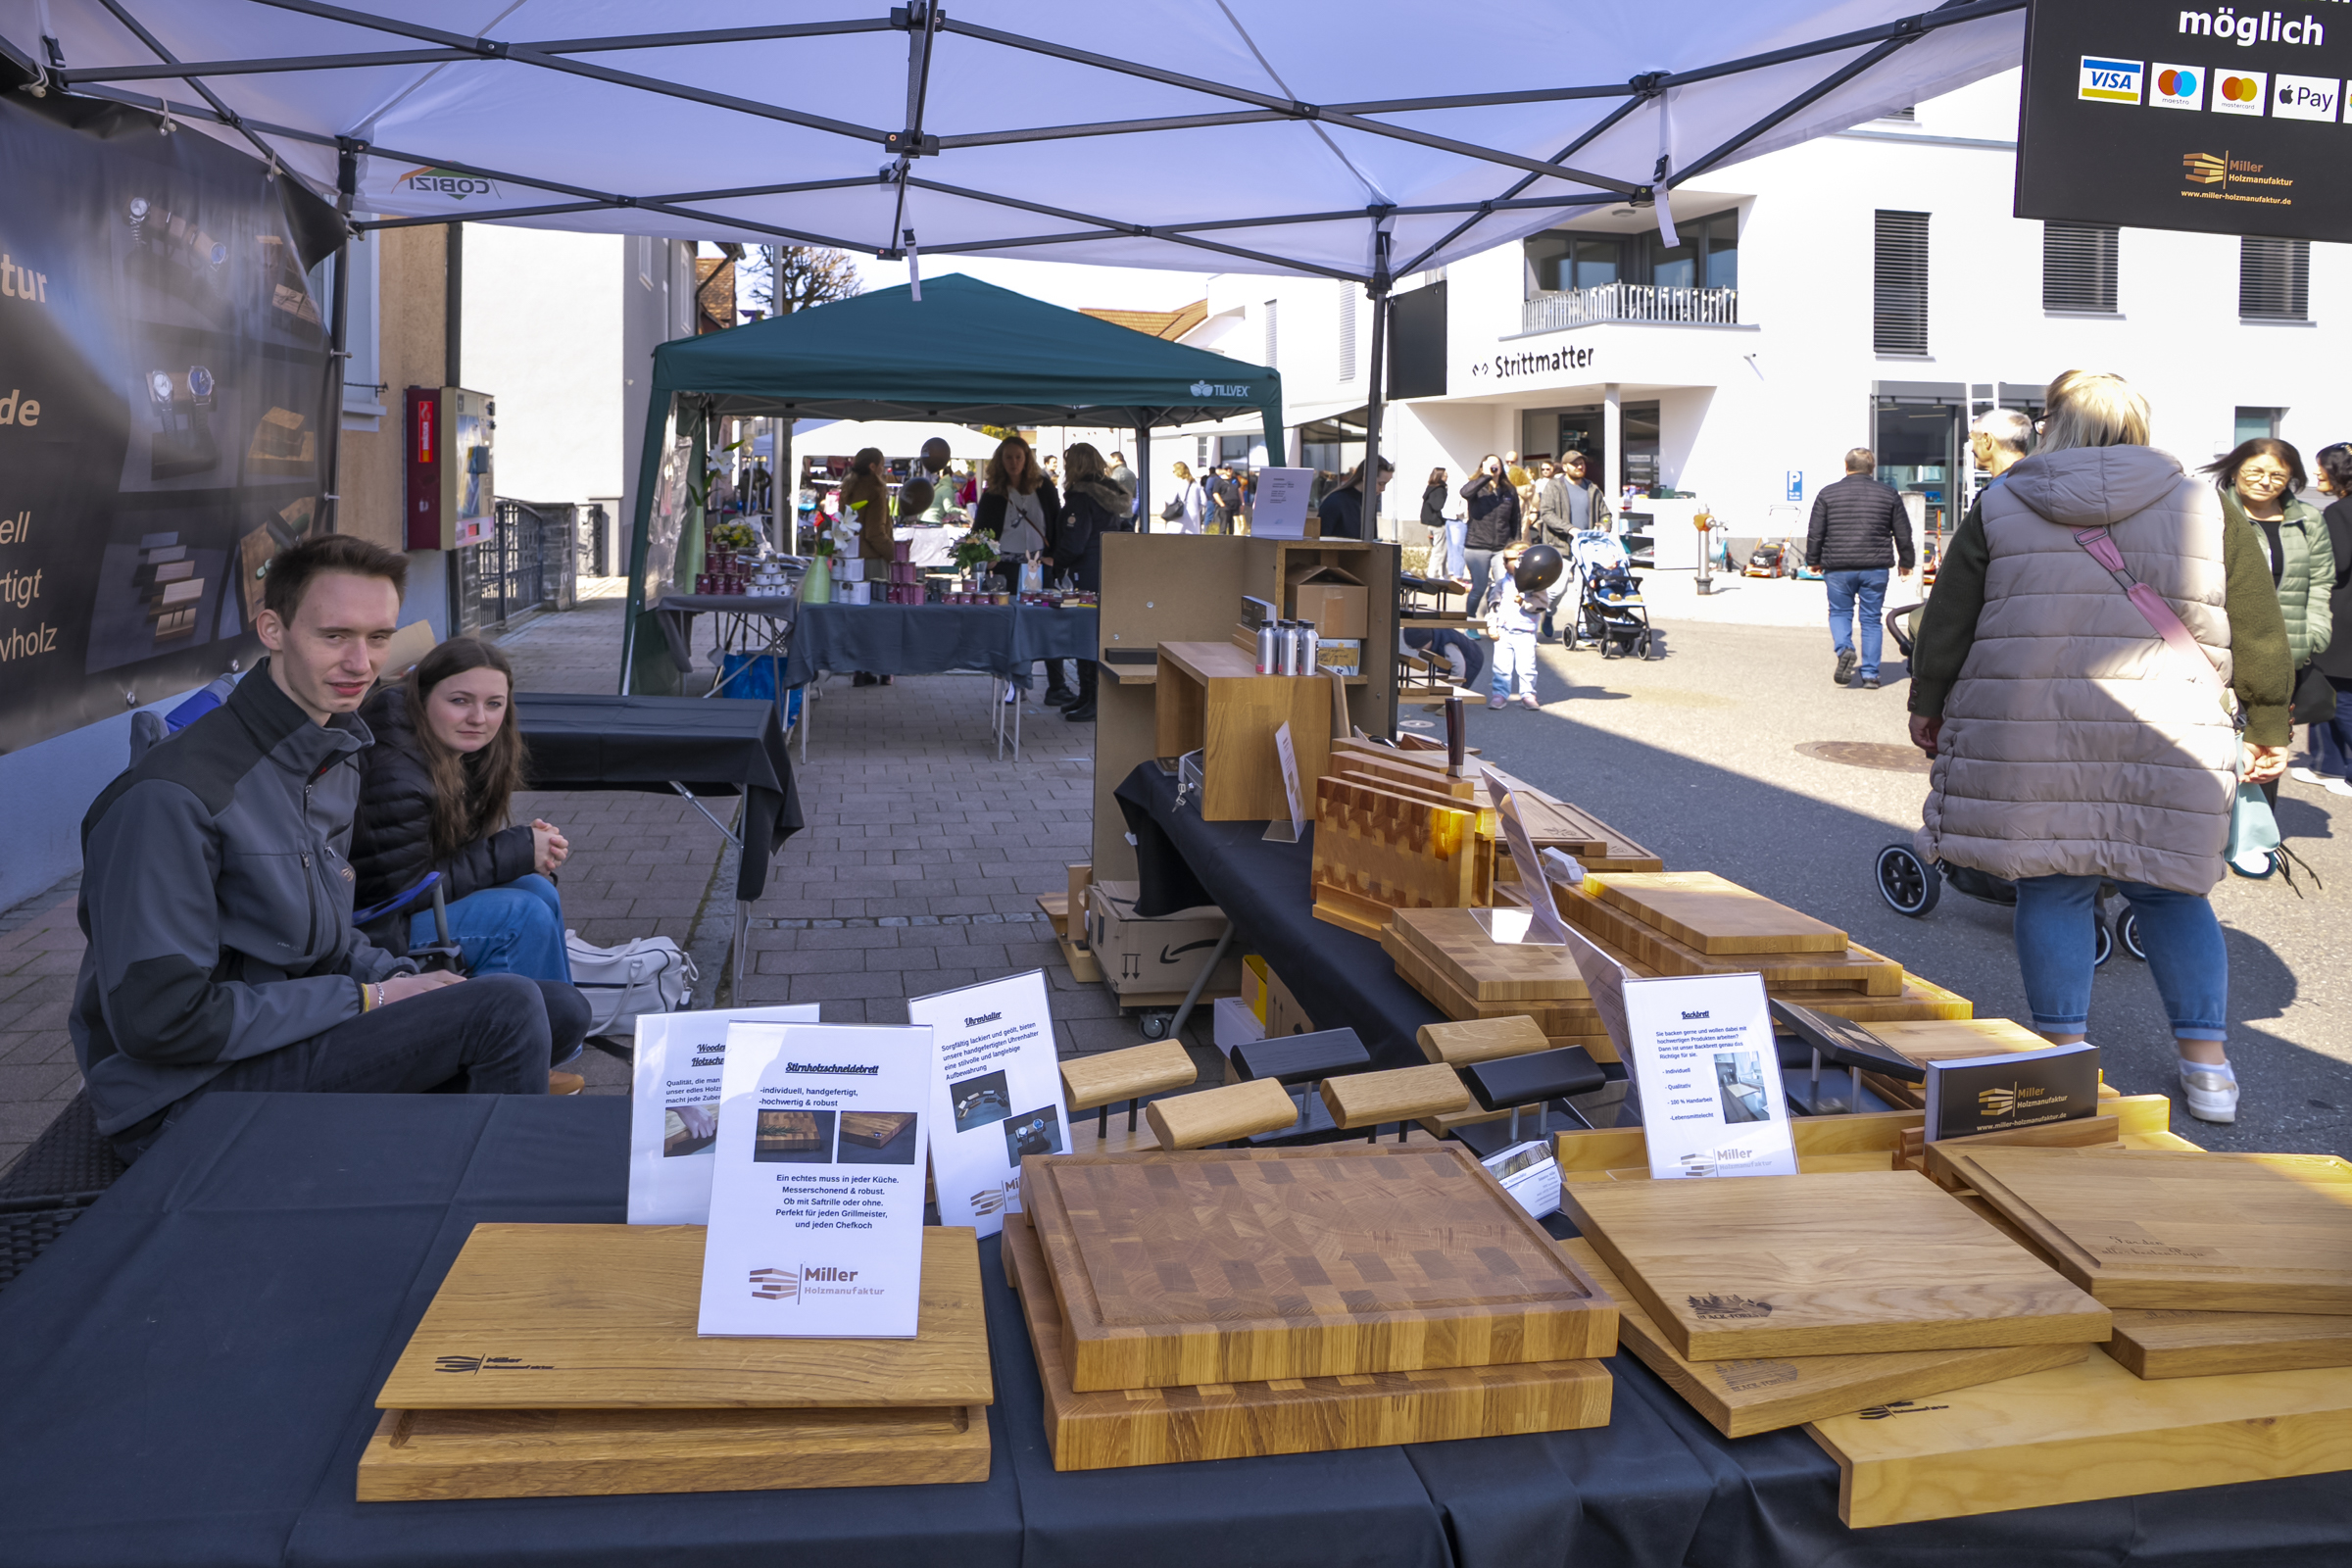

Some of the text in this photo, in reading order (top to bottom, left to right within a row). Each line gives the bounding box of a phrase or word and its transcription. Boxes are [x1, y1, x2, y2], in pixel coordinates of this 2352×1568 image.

[2179, 7, 2325, 46] möglich
[2090, 71, 2132, 89] VISA
[2162, 97, 2189, 106] maestro
[2221, 101, 2255, 110] mastercard
[2297, 86, 2333, 112] Pay
[2230, 160, 2264, 172] Miller
[2229, 174, 2293, 186] Holzmanufaktur
[2180, 190, 2291, 205] www.miller-holzmanufaktur.de
[1495, 345, 1593, 378] Strittmatter
[1214, 384, 1250, 397] TILLVEX
[1788, 470, 1801, 491] P
[964, 1011, 1002, 1027] Uhrenhalter
[1682, 1010, 1710, 1020] Backbrett
[941, 1022, 1036, 1052] Sorgfältig lackiert und geölt, bieten
[943, 1031, 1039, 1061] unsere handgefertigten Uhrenhalter
[958, 1055, 980, 1067] stilvolle
[981, 1053, 992, 1061] und
[992, 1046, 1020, 1057] langlebige
[785, 1062, 879, 1075] Stirnholzschneidebrett
[946, 1064, 987, 1080] Aufbewahrung
[760, 1087, 858, 1098] -individuell, handgefertigt,
[2018, 1087, 2045, 1099] Miller
[759, 1099, 804, 1107] -hochwertig
[2017, 1094, 2068, 1109] Holzmanufaktur
[1670, 1112, 1714, 1121] -Lebensmittelecht
[1977, 1111, 2067, 1131] www.miller-holzmanufaktur.de
[1717, 1148, 1752, 1161] Miller
[1719, 1160, 1773, 1170] Holzmanufaktur
[782, 1186, 848, 1195] Messerschonend
[818, 1209, 840, 1218] jeden
[841, 1209, 888, 1218] Grillmeister,
[805, 1267, 858, 1282] Miller
[805, 1286, 885, 1295] Holzmanufaktur
